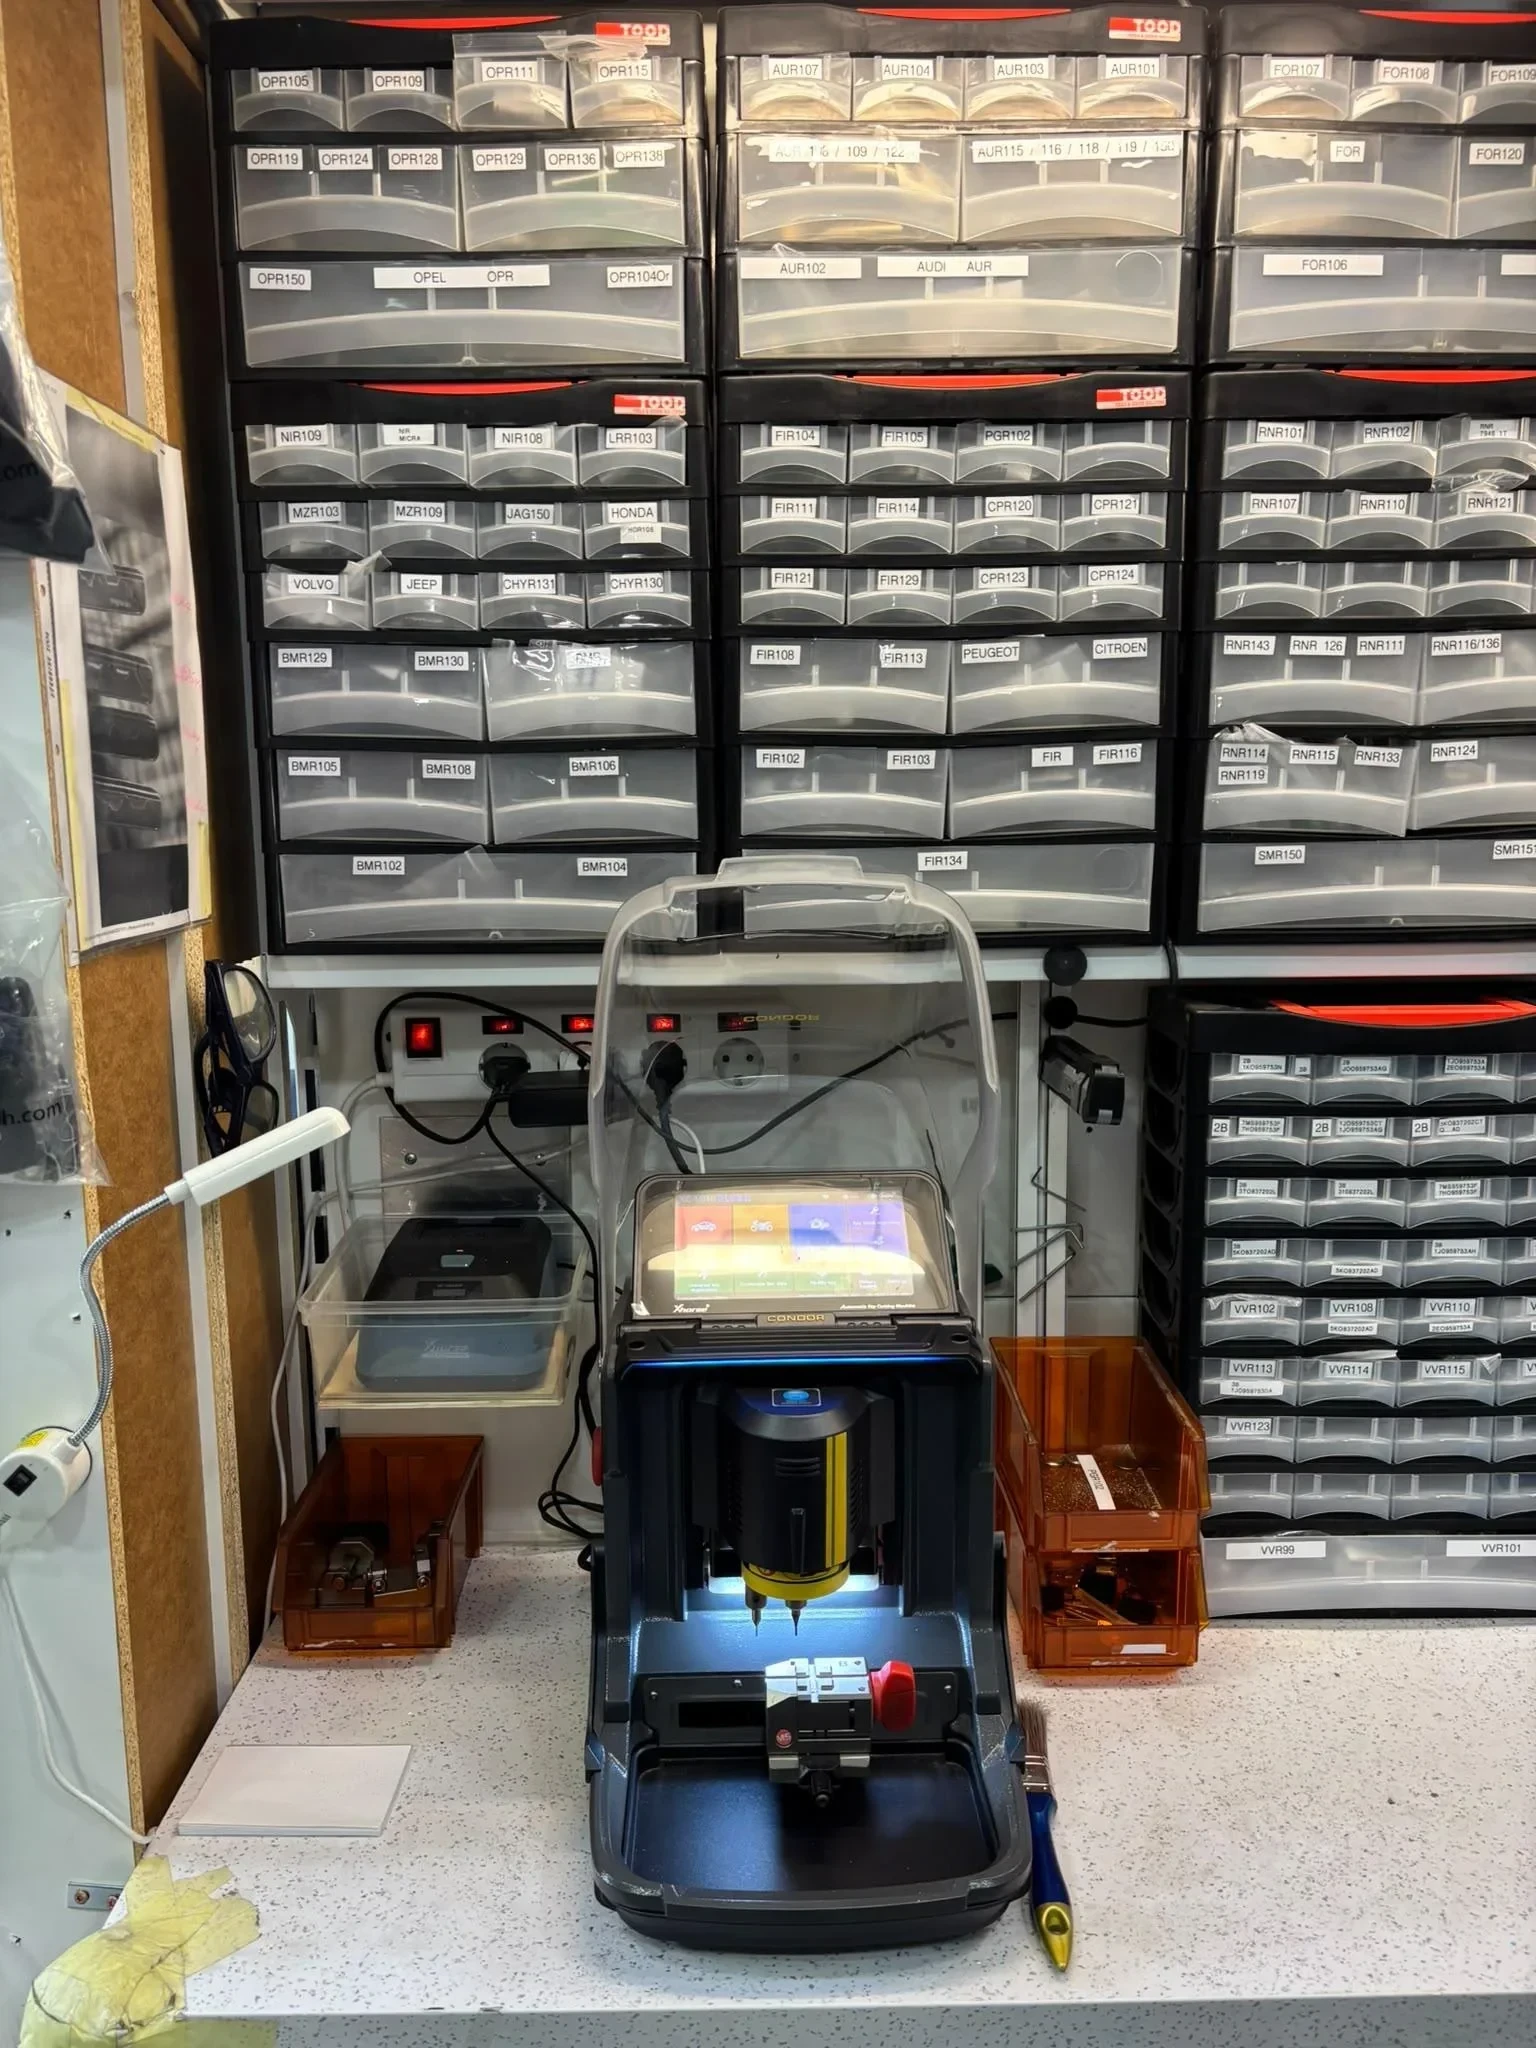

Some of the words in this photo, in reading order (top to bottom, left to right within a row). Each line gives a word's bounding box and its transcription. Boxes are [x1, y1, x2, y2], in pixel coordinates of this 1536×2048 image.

[486, 65, 534, 80] OPR111
[599, 65, 649, 78] OPR115
[772, 64, 819, 76] AUR107
[883, 64, 930, 77] AUR104
[997, 63, 1045, 76] AUR103
[1111, 63, 1156, 75] AUR101
[1273, 64, 1320, 76] FOR107
[1383, 67, 1430, 80] FOR108
[1491, 68, 1536, 82] FOR109
[261, 75, 309, 89] OPR105
[375, 75, 423, 90] OPR109
[616, 150, 663, 162] OPR138
[848, 146, 867, 156] 109
[978, 145, 1023, 158] AUR115
[1042, 144, 1061, 155] 116
[1080, 142, 1099, 154] 118
[1336, 145, 1360, 158] FOR
[1476, 148, 1522, 160] FOR120
[250, 153, 299, 167] OPR119
[321, 153, 369, 167] OPR124
[391, 153, 439, 167] OPR128
[475, 153, 524, 167] OPR129
[549, 153, 596, 165] OPR136
[780, 262, 826, 275] AUR102
[916, 261, 946, 274] AUDI
[967, 260, 992, 273] AUR
[1301, 259, 1348, 271] FOR106
[257, 272, 305, 286] OPR150
[413, 272, 446, 284] OPEL
[486, 271, 514, 283] OPR
[281, 430, 322, 442] NIR109
[608, 432, 653, 444] LRR103
[775, 430, 816, 443] FIR104
[885, 431, 924, 444] FIR105
[985, 430, 1031, 442] PGR102
[1259, 427, 1303, 439] RNR101
[1365, 426, 1410, 439] RNR102
[501, 433, 543, 445] NIR108
[775, 502, 814, 515] FIR111
[878, 502, 916, 515] FIR114
[987, 499, 1032, 512] CPR120
[1093, 498, 1137, 511] CPR121
[1252, 498, 1297, 510] RNR107
[1361, 499, 1405, 511] RNR110
[1467, 497, 1511, 509] RNR121
[292, 506, 339, 519] MZR103
[396, 506, 443, 519] MZR109
[507, 507, 551, 520] JAG150
[611, 507, 653, 519] HONDA
[774, 572, 811, 585] FIR121
[880, 574, 919, 587] FIR129
[980, 571, 1026, 584] CPR123
[1090, 569, 1135, 581] CPR124
[293, 579, 334, 591] VOLVO
[406, 578, 437, 591] JEEP
[504, 577, 555, 590] CHYR131
[610, 576, 663, 589] CHYR130
[1094, 641, 1147, 655] CITROEN
[1226, 640, 1270, 651] RNR143
[1292, 641, 1317, 651] RNR
[1324, 641, 1343, 651] 126
[1360, 641, 1403, 651] RNR111
[1433, 638, 1499, 650] RNR116/136
[756, 648, 795, 661] FIR108
[885, 651, 924, 664] FIR113
[963, 645, 1018, 659] PEUGEOT
[281, 652, 327, 665] BMR129
[417, 655, 465, 668] BMR130
[1042, 751, 1062, 763] FIR
[1099, 747, 1138, 760] FIR116
[1222, 748, 1266, 758] RNR114
[1292, 749, 1335, 760] RNR115
[1356, 751, 1400, 762] RNR133
[1432, 746, 1476, 756] RNR124
[762, 753, 800, 765] FIR102
[892, 754, 930, 766] FIR103
[291, 760, 337, 773] BMR105
[426, 763, 472, 775] BMR108
[571, 760, 616, 772] BMR106
[1221, 770, 1265, 781] RNR119
[924, 854, 962, 867] FIR134
[1258, 849, 1302, 860] SMR150
[356, 860, 402, 872] BMR102
[582, 860, 627, 872] BMR104
[1214, 1123, 1227, 1132] 2B
[1316, 1124, 1329, 1132] 2B
[1414, 1123, 1428, 1132] 2B
[1235, 1304, 1275, 1313] VVR102
[1333, 1303, 1373, 1312] VVR108
[1430, 1303, 1470, 1312] VVR110
[1233, 1364, 1272, 1373] VVR113
[1329, 1366, 1369, 1374] VVR114
[1425, 1365, 1465, 1374] VVR115
[1231, 1421, 1270, 1432] VVR123
[1261, 1545, 1295, 1555] VVR99
[1481, 1543, 1521, 1553] VVR101
